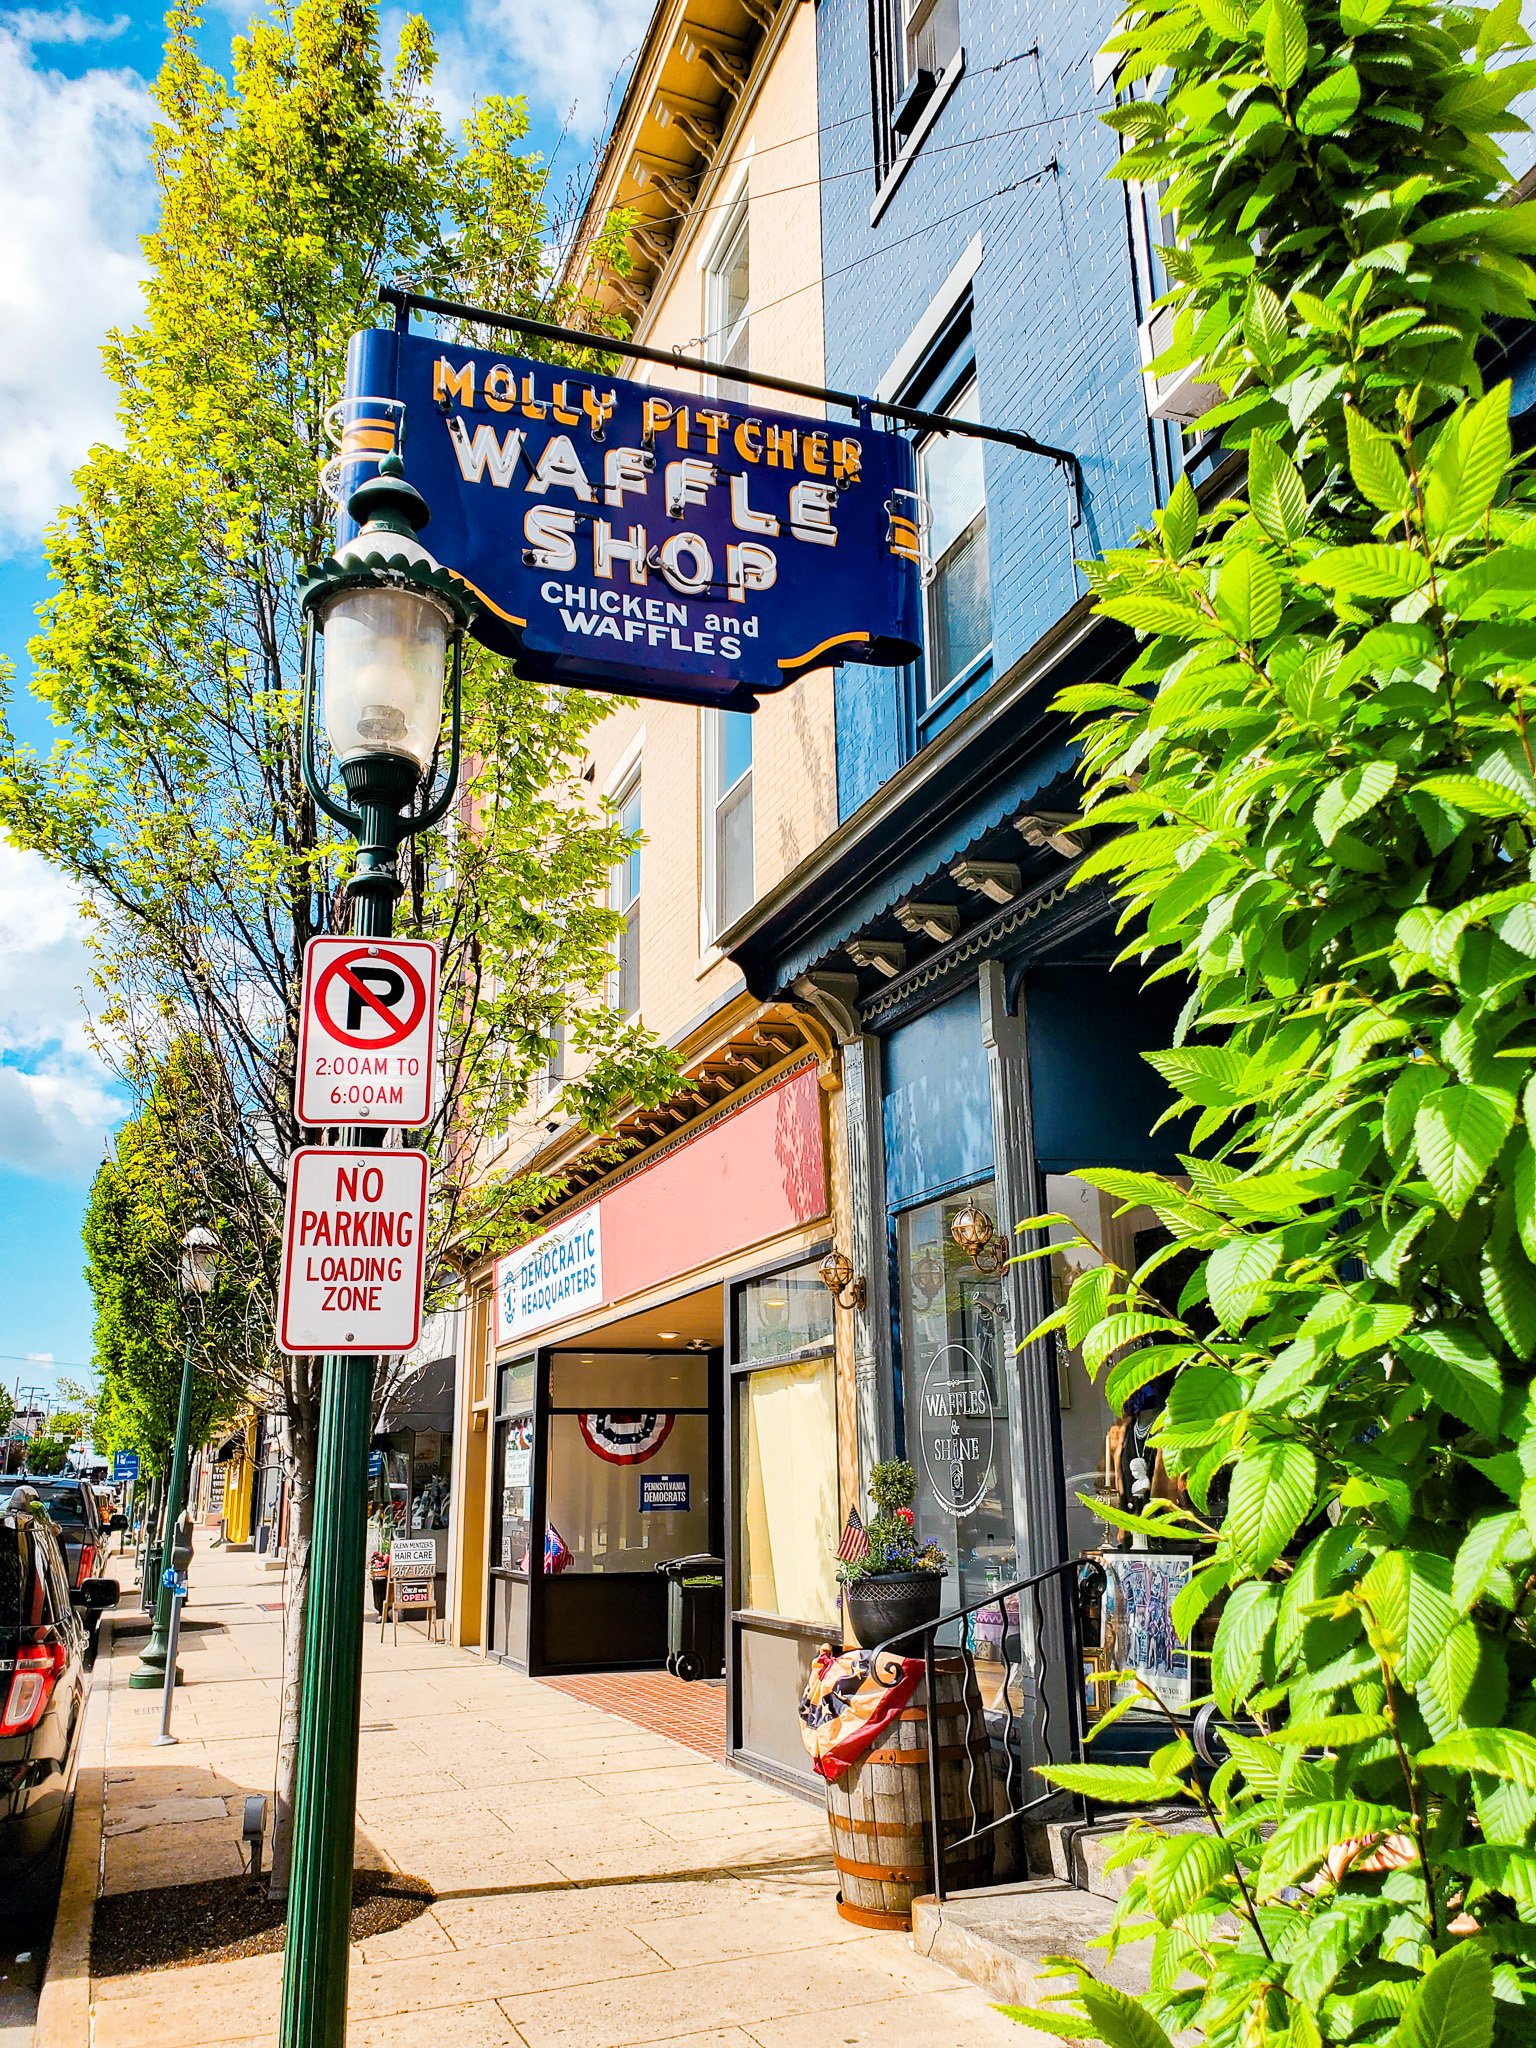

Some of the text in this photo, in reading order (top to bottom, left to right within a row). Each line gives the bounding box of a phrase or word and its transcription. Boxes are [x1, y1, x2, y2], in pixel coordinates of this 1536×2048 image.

[433, 356, 862, 483] MOLLY PITCHER
[448, 416, 837, 547] WAFFLE
[522, 504, 777, 602] SHOP
[540, 581, 759, 638] CHICKEN and
[558, 607, 742, 660] WAFFLES
[316, 1057, 420, 1077] 2:00AM TO
[331, 1086, 403, 1105] 6:00AM
[336, 1167, 384, 1203] NO
[300, 1211, 413, 1248] PARKING
[306, 1257, 402, 1283] LOADING
[521, 1228, 595, 1291] DEMOCRATIC
[322, 1287, 382, 1312] ZONE
[521, 1264, 596, 1317] HEADQUARTERS
[925, 1390, 986, 1417] WAFFLES
[950, 1420, 960, 1436] &
[934, 1438, 980, 1461] SHINE
[644, 1482, 686, 1491] PENNSYLVANIA
[644, 1491, 687, 1502] DEMOCRATS
[394, 1551, 433, 1560] HAIR CARE
